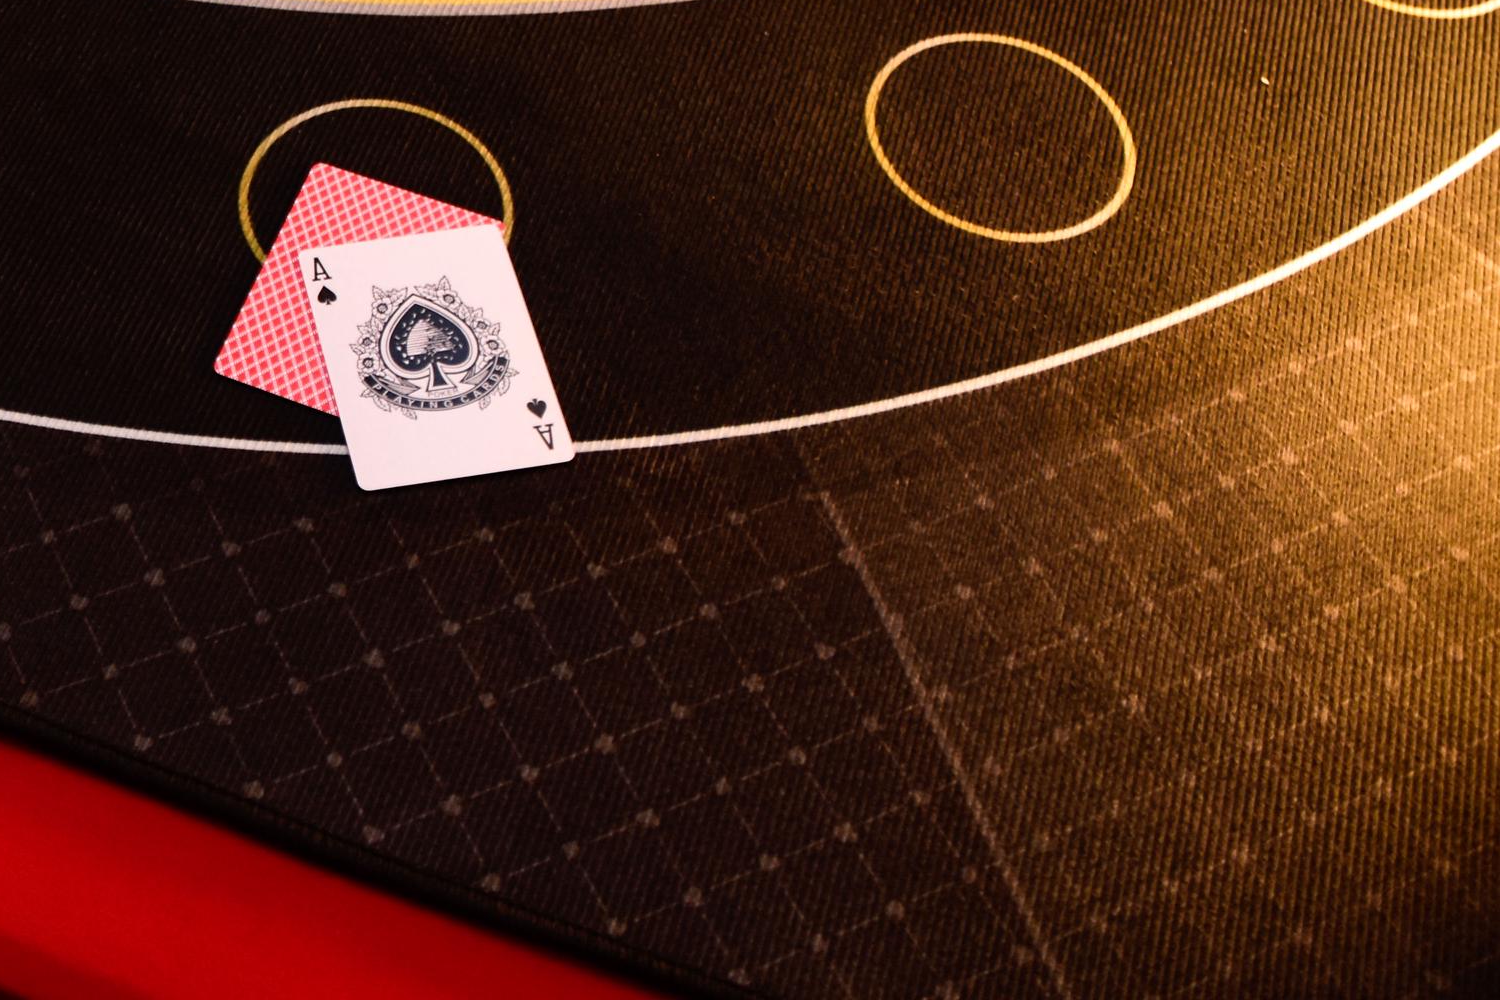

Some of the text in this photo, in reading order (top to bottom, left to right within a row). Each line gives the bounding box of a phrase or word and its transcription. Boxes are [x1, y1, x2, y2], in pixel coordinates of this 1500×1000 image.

[312, 257, 332, 281] A
[372, 363, 506, 409] PLAYING CARDS
[534, 424, 554, 450] A
